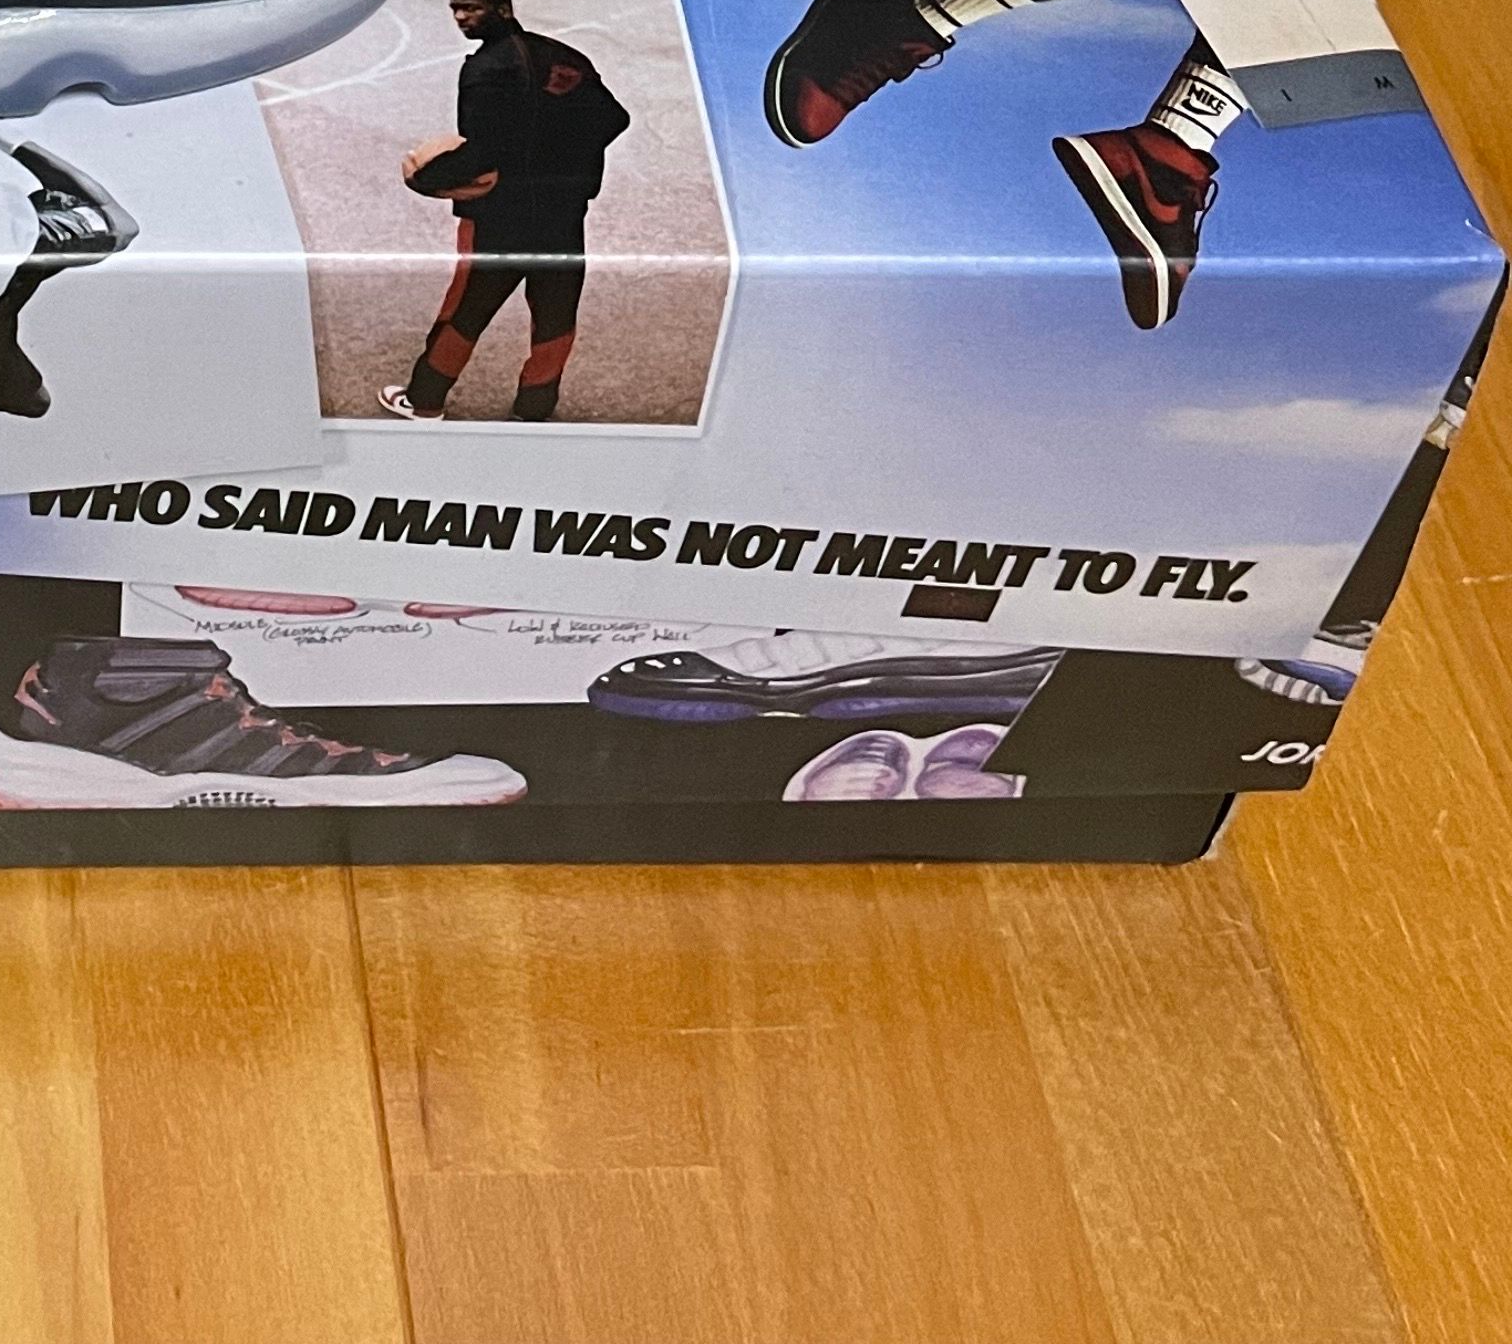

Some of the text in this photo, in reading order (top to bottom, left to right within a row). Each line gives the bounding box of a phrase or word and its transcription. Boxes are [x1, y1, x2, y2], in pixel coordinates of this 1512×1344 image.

[1188, 83, 1228, 113] NIKE
[28, 480, 1259, 603] WHO SAID MAN WAS NOT MEANT TO FLY.
